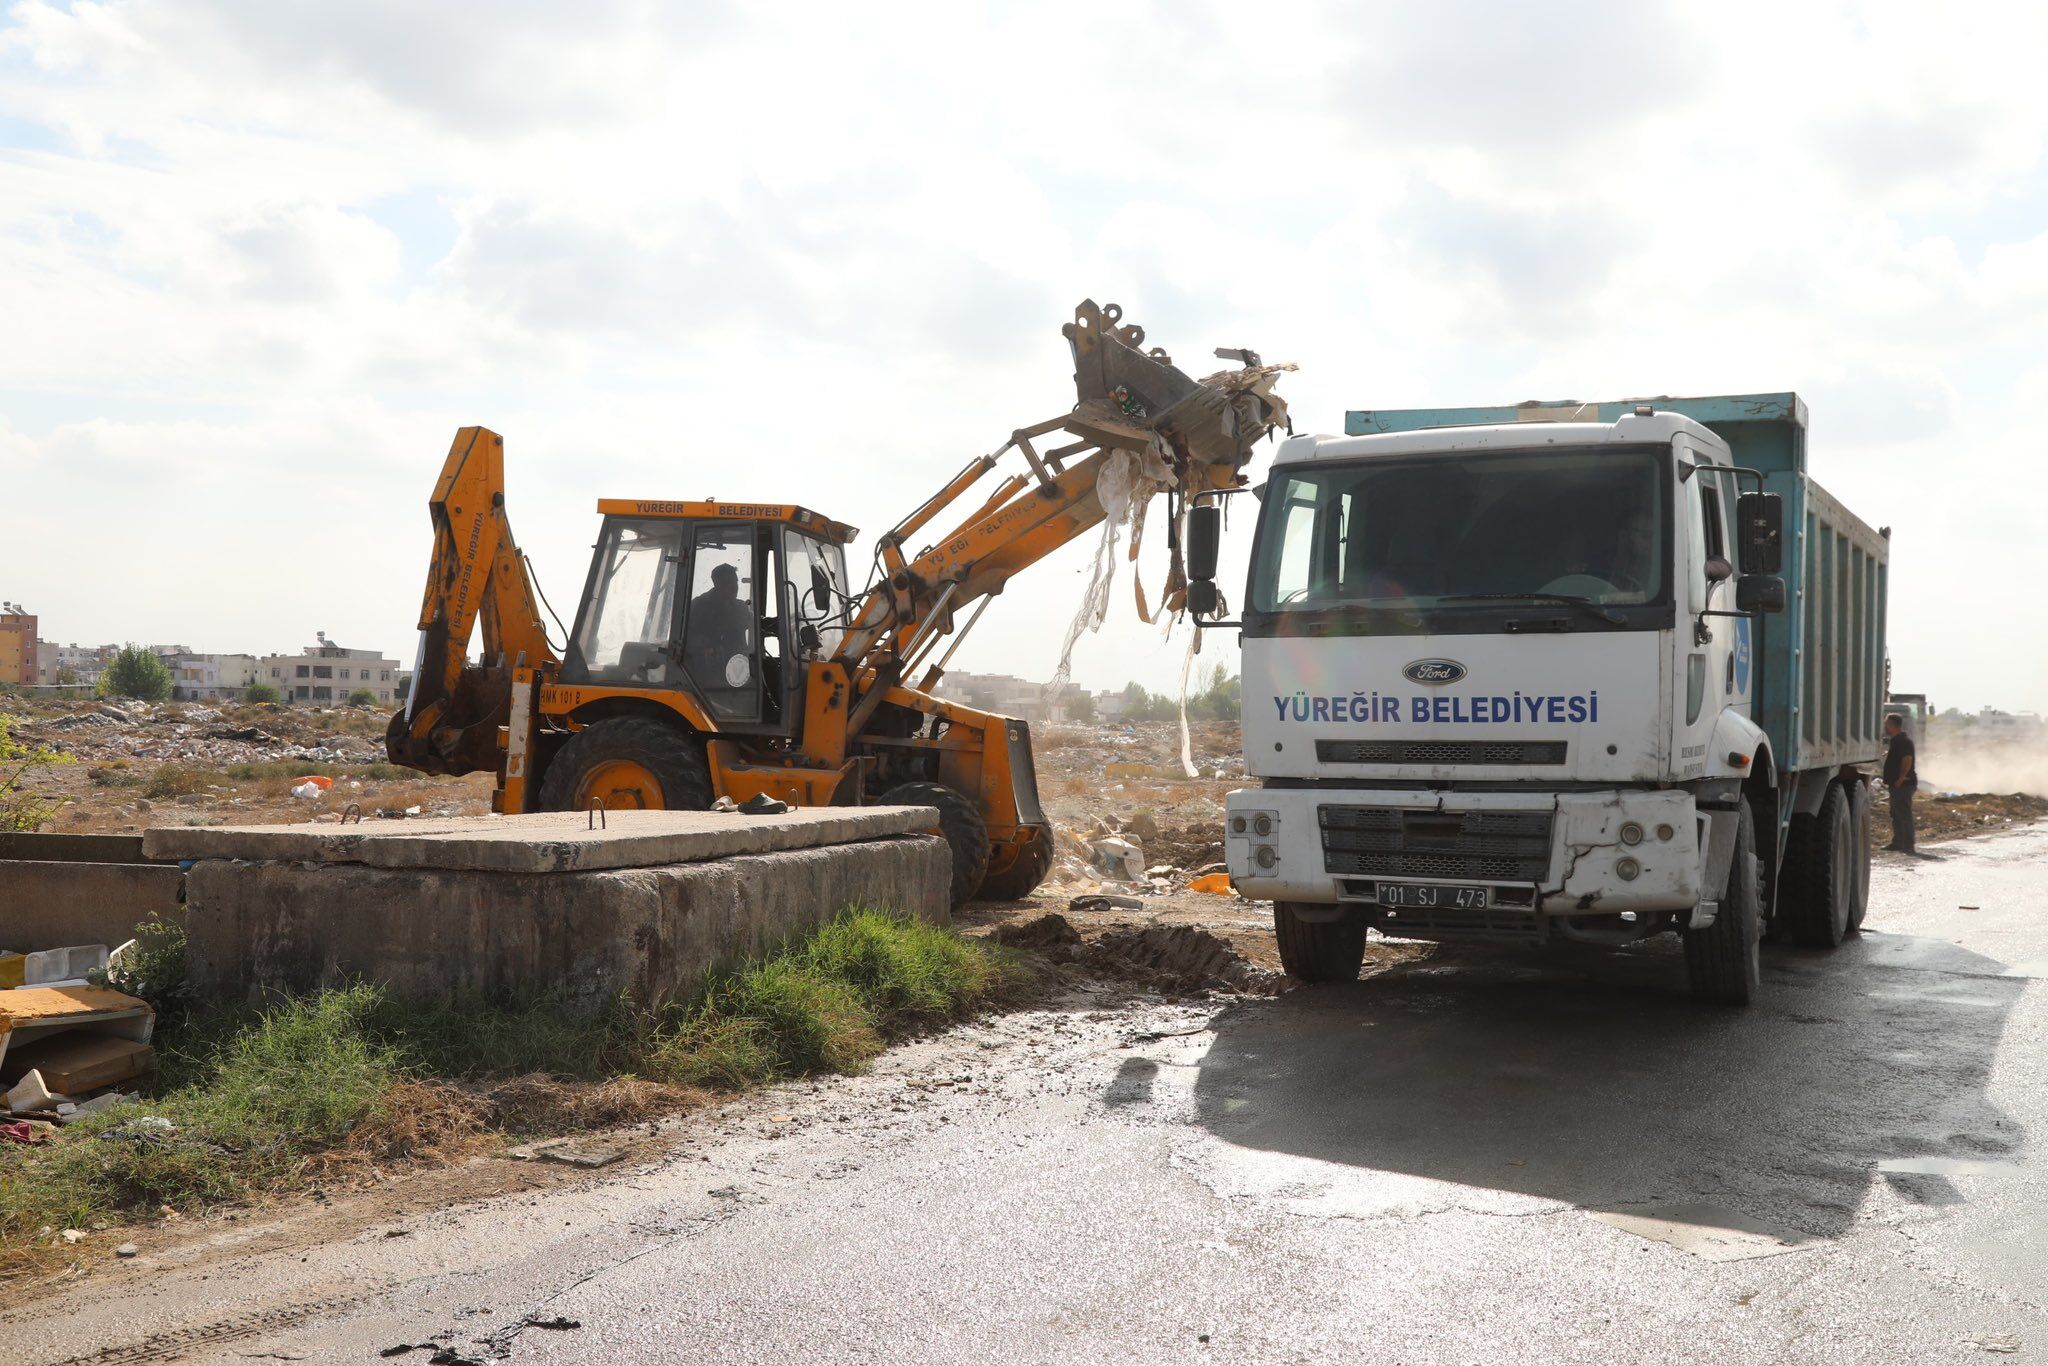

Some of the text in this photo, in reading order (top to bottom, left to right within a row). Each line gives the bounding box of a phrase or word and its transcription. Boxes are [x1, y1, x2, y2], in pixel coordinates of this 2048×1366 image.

[1417, 664, 1451, 679] Ford
[1274, 691, 1598, 723] YÜREĞİR BELEDİYESİ
[1389, 886, 1486, 908] 01 SJ 473
